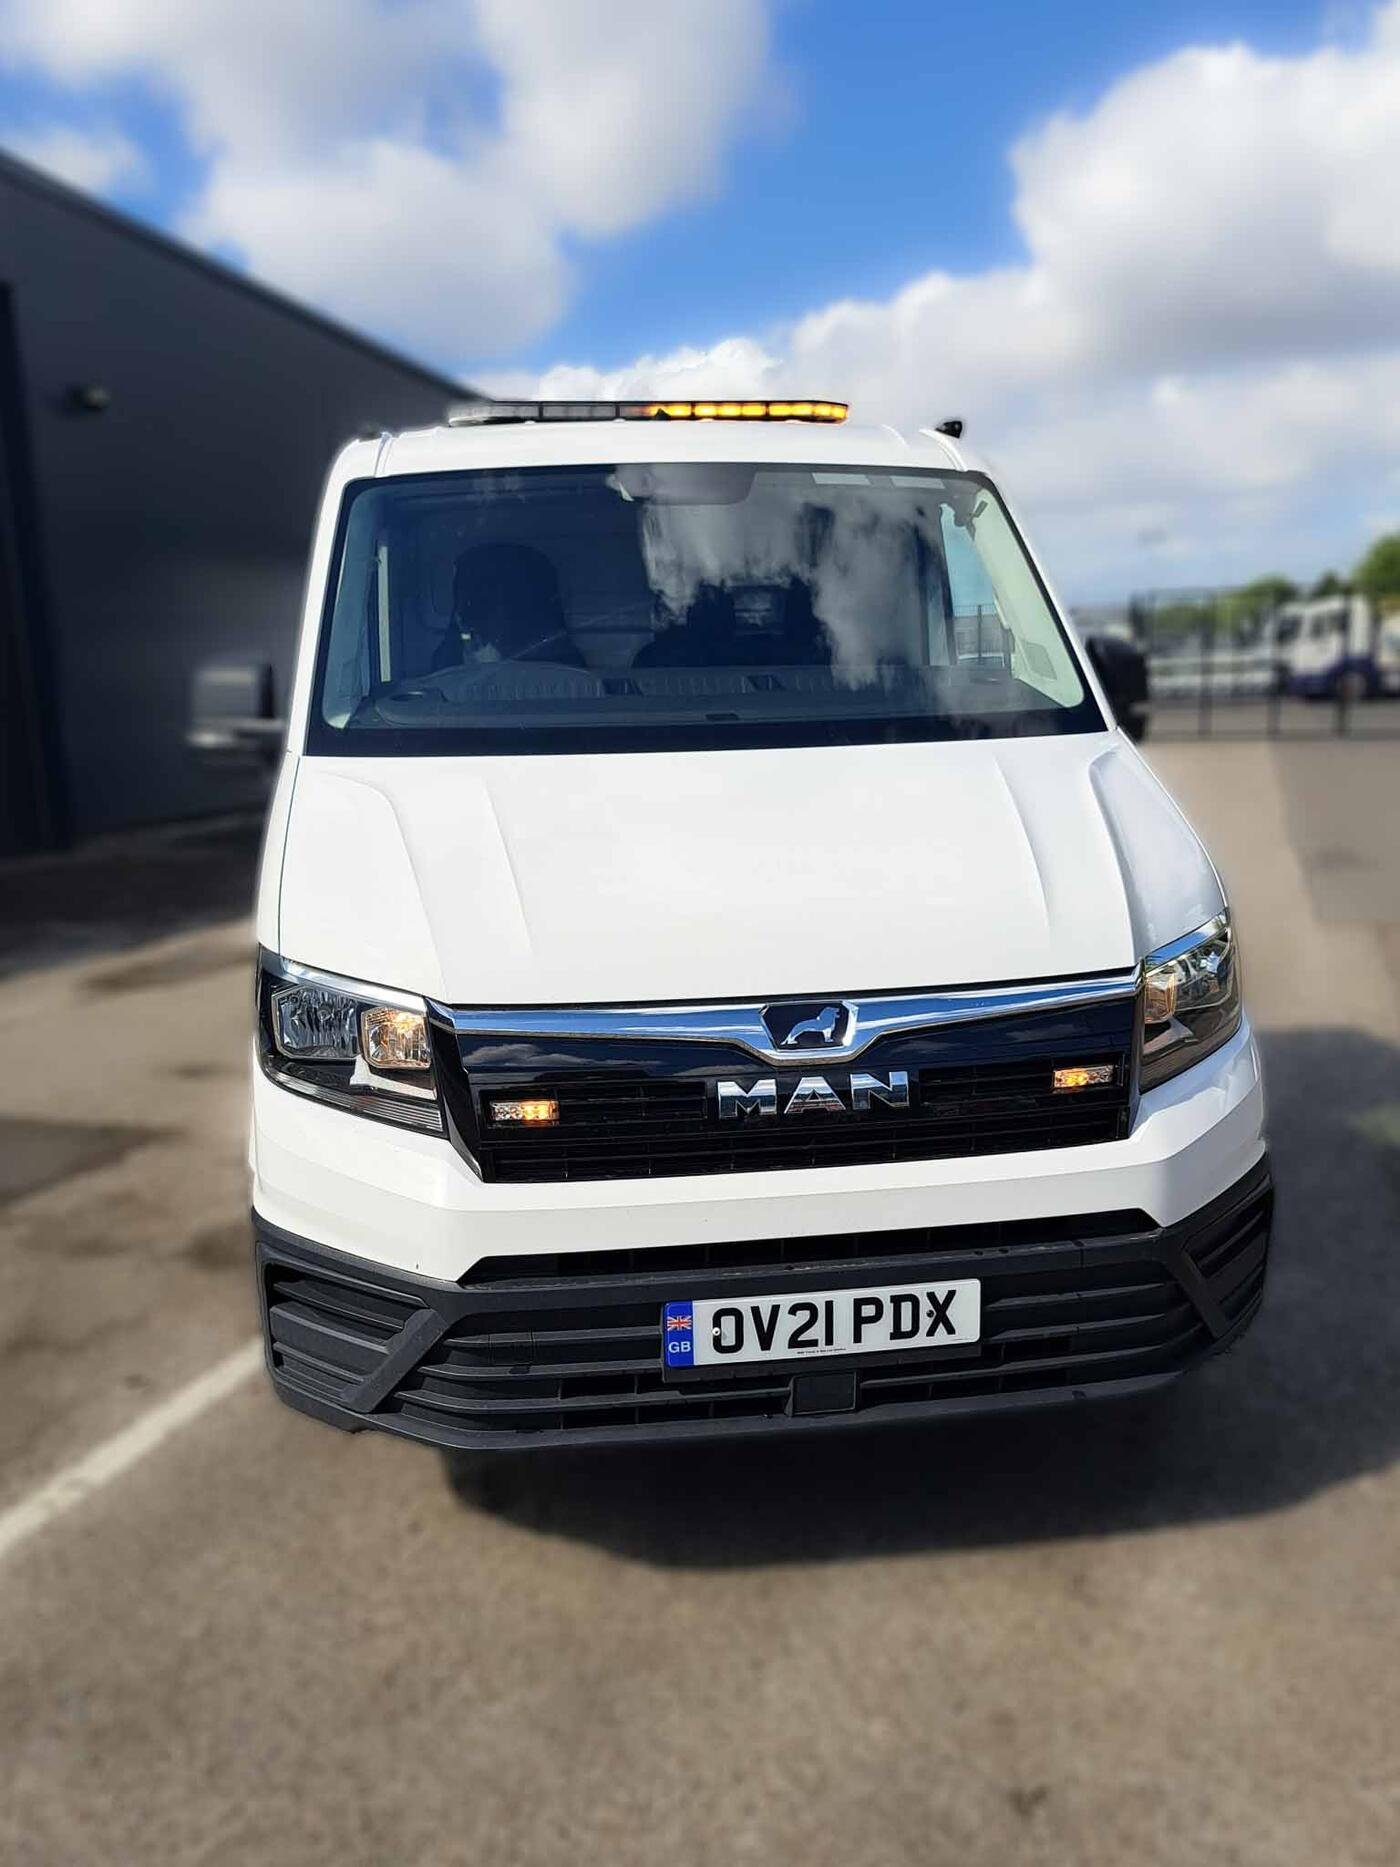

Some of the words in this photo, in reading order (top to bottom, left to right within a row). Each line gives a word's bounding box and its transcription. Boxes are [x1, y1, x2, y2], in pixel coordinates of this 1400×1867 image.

[718, 1071, 910, 1119] MAN
[711, 1300, 834, 1355] OV21
[853, 1289, 957, 1344] PDX
[668, 1340, 692, 1353] GB
